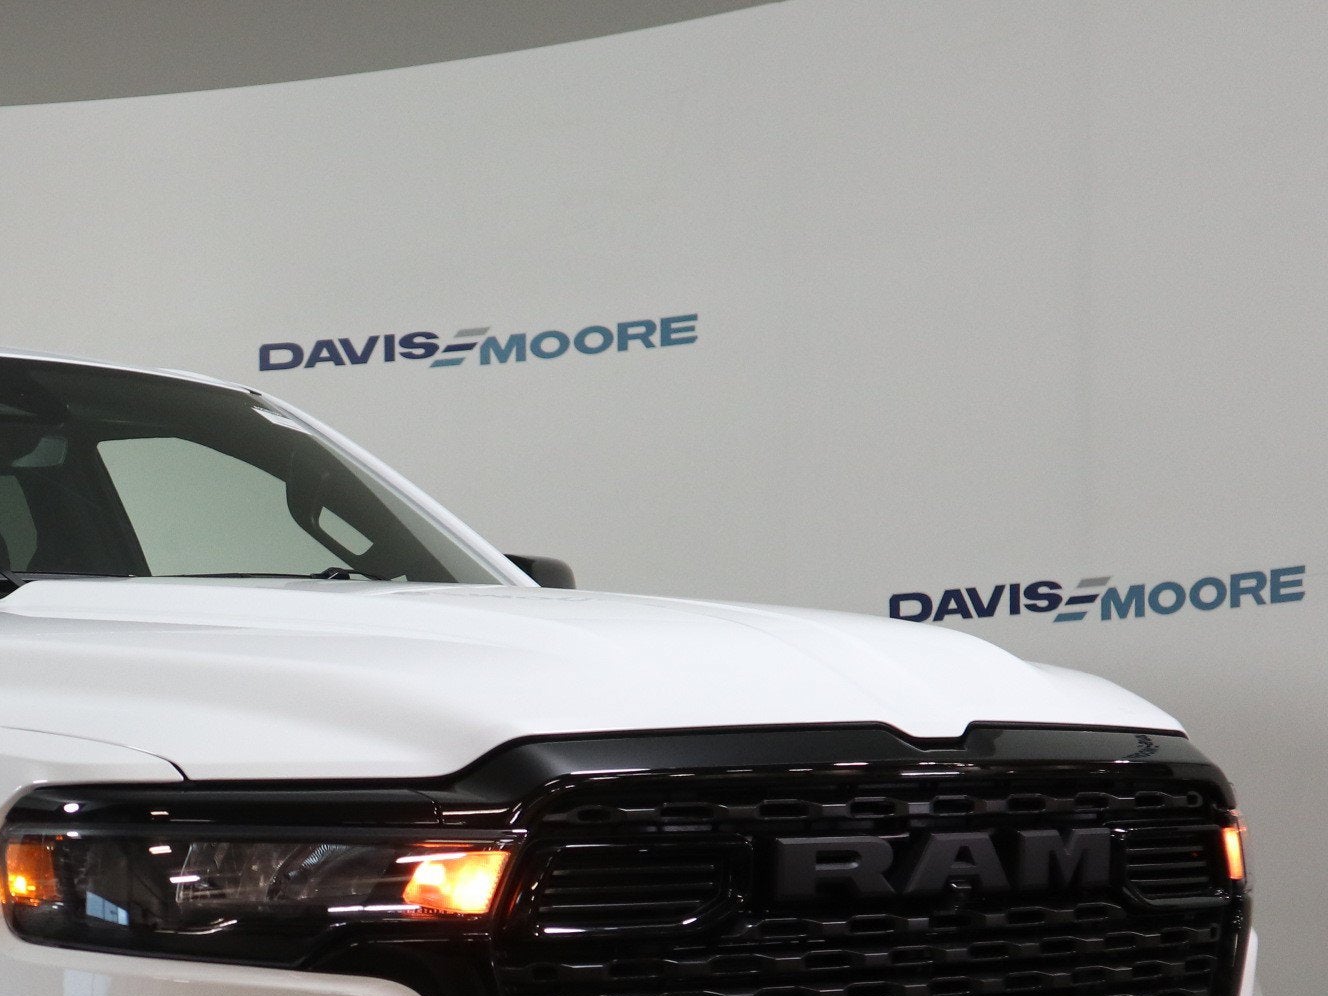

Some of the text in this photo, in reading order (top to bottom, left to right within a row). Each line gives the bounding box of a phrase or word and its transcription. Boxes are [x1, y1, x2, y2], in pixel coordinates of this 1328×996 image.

[258, 313, 699, 372] DAVIS MOORE
[889, 565, 1306, 623] DAVIS MOORE
[776, 827, 1112, 897] RAM
